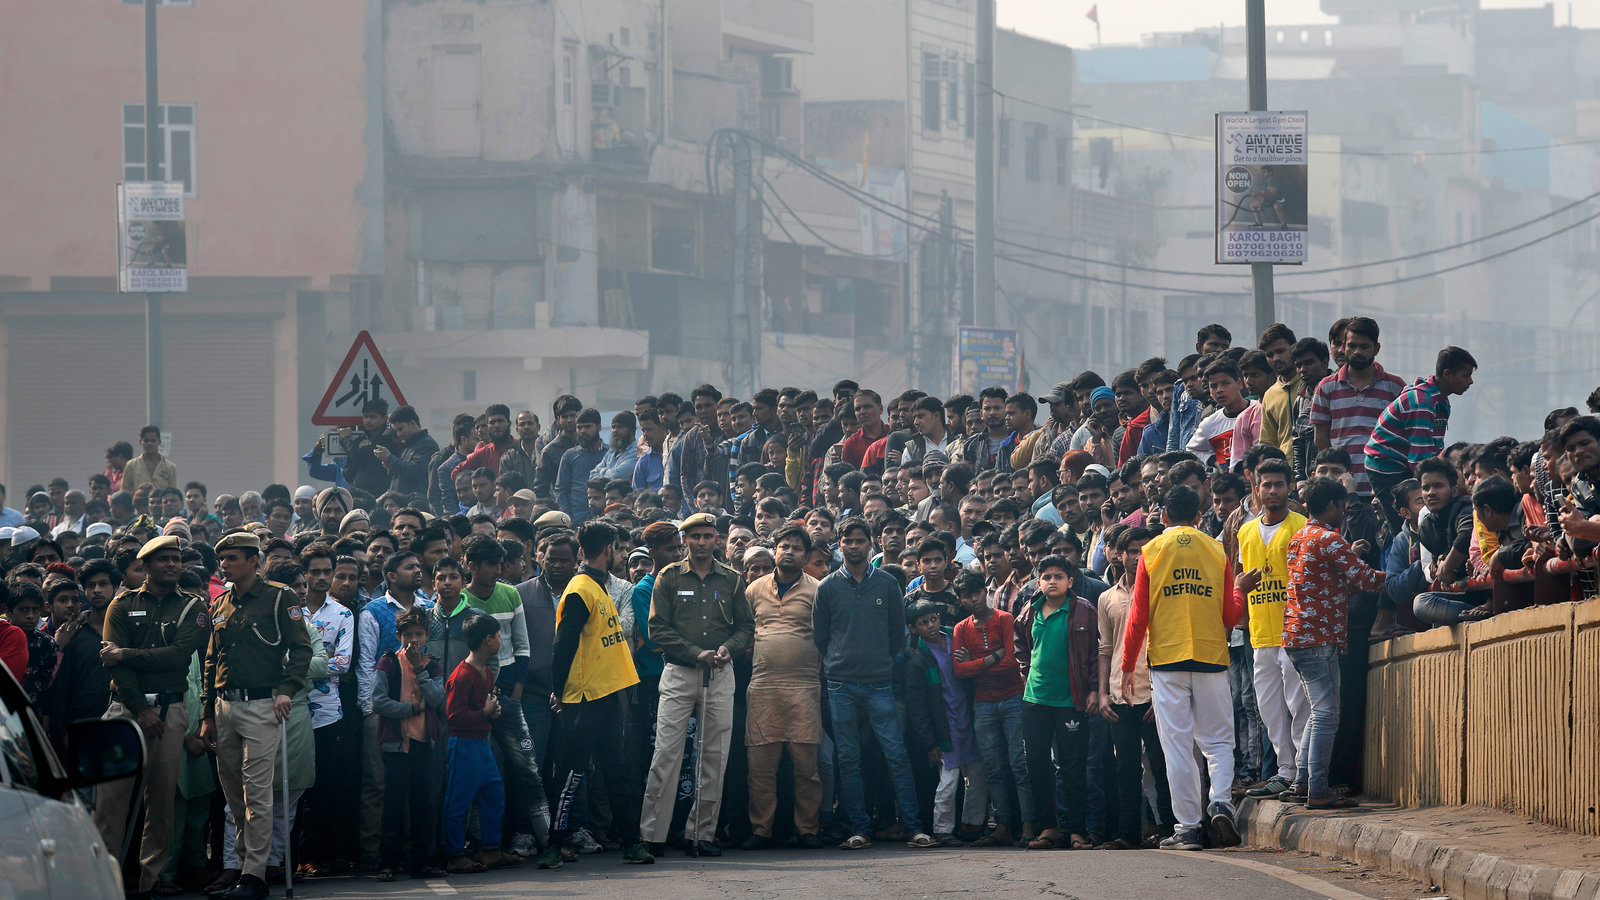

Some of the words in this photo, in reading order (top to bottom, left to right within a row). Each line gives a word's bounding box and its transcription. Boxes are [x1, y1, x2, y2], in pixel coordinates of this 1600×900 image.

[1245, 134, 1303, 144] ANYTIME
[1246, 145, 1303, 154] FITNESS
[1285, 155, 1304, 163] place.
[1229, 232, 1266, 242] KAROL
[1269, 232, 1301, 242] BAGH
[1173, 568, 1202, 580] CIVIL
[1163, 582, 1213, 598] DEFENCE
[1250, 591, 1288, 605] DEFENC
